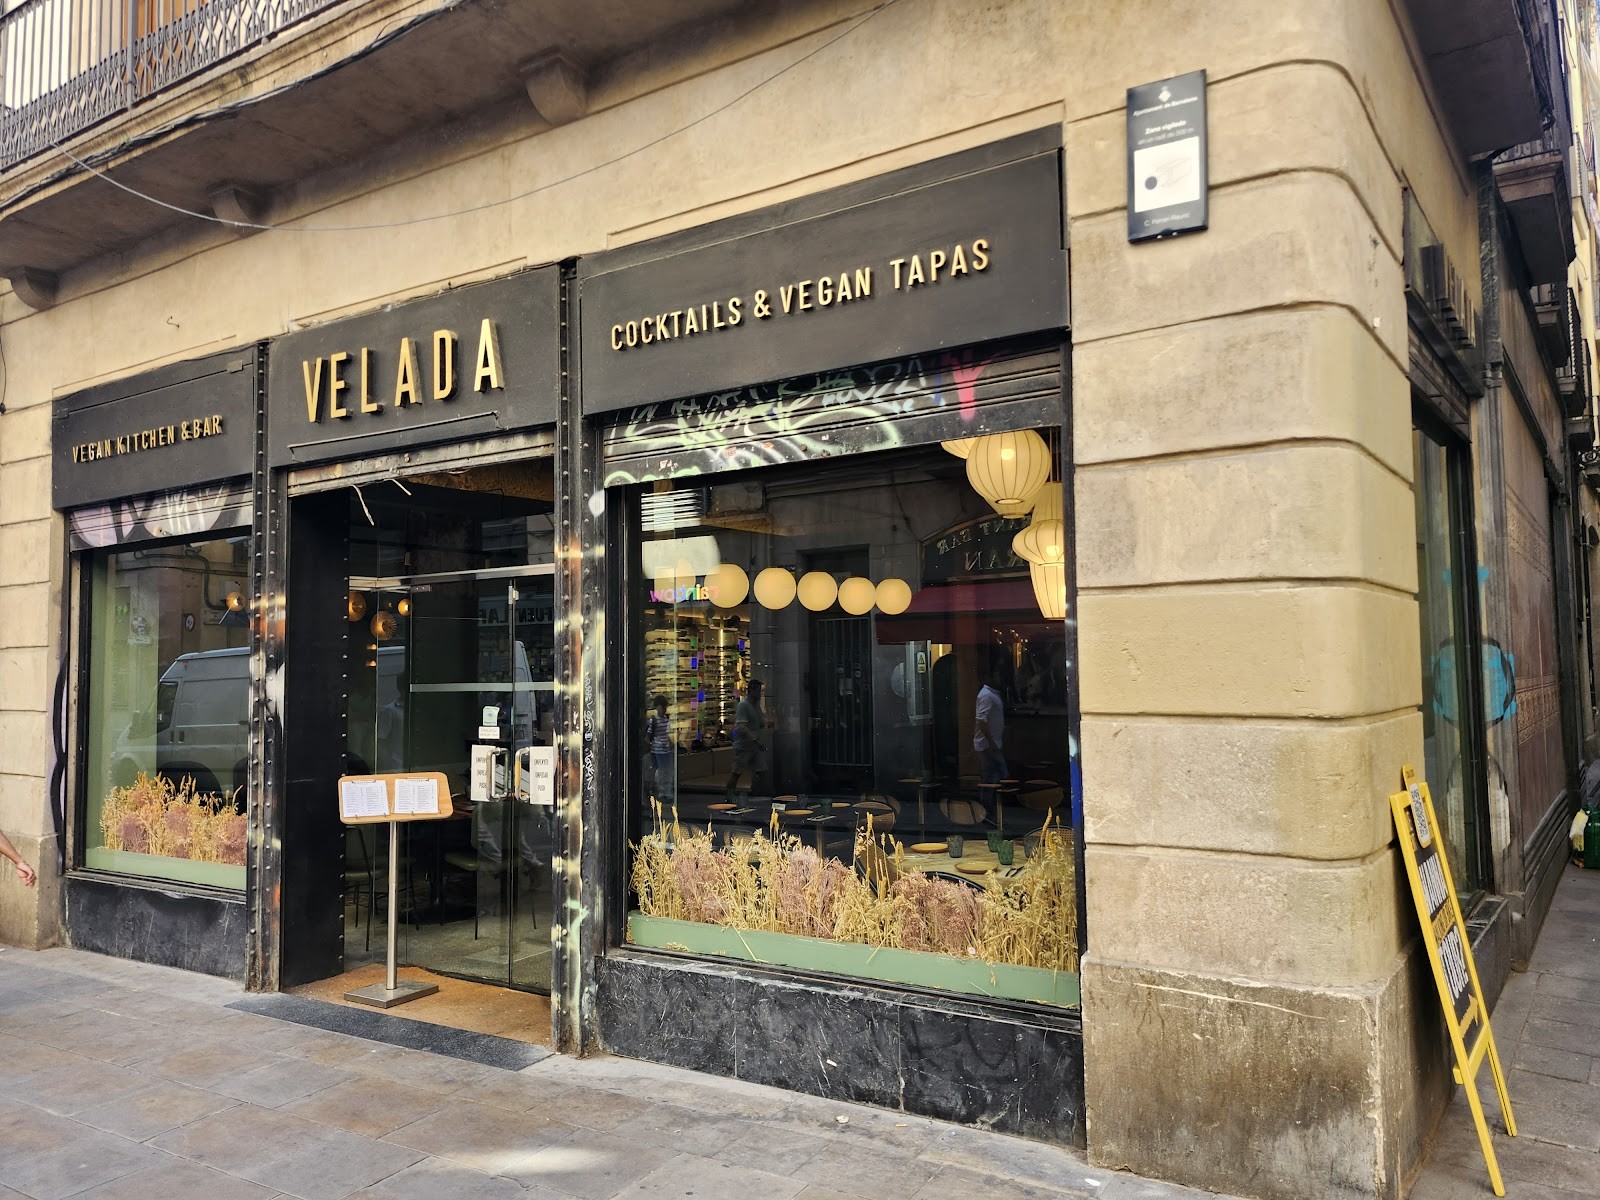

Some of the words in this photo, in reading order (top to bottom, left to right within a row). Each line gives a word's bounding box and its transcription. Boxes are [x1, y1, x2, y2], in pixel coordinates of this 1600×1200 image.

[611, 297, 743, 351] COCKTAILS
[753, 289, 772, 319] &
[780, 266, 872, 315] VEGAN
[889, 239, 990, 290] TAPAS
[302, 318, 504, 424] VELADA
[72, 438, 112, 464] VEGAN
[117, 425, 175, 455] KITCHEN
